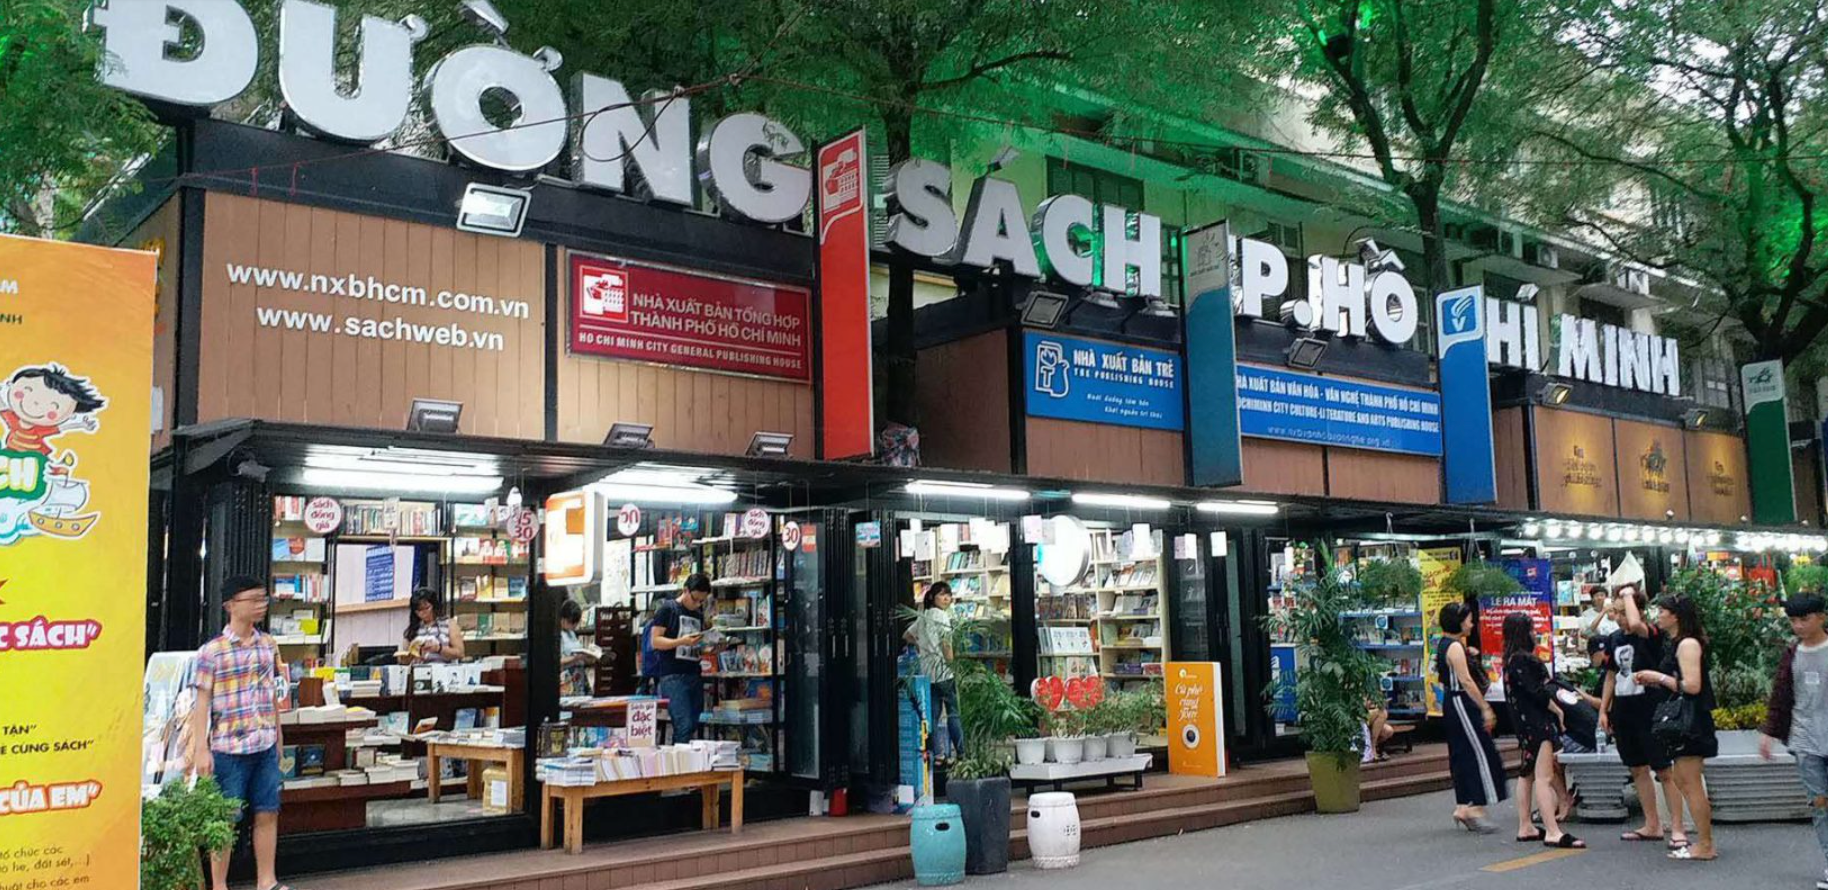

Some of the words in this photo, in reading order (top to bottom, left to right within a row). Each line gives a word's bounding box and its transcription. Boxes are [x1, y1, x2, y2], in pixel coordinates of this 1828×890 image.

[886, 146, 1161, 297] SÁCH
[1558, 313, 1681, 396] MINH
[226, 262, 530, 319] www.nxbhcm.com.vn
[256, 306, 504, 351] www.sachweb.vn
[630, 310, 683, 331] THÀNH
[685, 318, 716, 336] PHỐ
[718, 321, 739, 339] HỒ
[741, 326, 765, 343] CHÍ
[766, 330, 801, 347] MINH
[632, 292, 664, 311] NHÀ
[666, 297, 702, 316] XUẤT
[704, 301, 733, 321] BẢN
[734, 306, 772, 326] TỔNG
[773, 314, 800, 331] HỢP
[578, 332, 594, 343] HO
[596, 333, 615, 347] CHI
[616, 336, 644, 351] MINH
[645, 340, 669, 353] CITY
[670, 344, 715, 359] GENERAL
[716, 349, 772, 366] PUBLISHING
[773, 356, 801, 369] HOUSE
[1073, 348, 1096, 368] NHÀ
[1101, 351, 1128, 372] XUẤT
[1131, 353, 1152, 375] BẢN
[1155, 358, 1174, 378] TRẺ
[1094, 370, 1143, 385] PUBLISHING
[1148, 377, 1174, 389] HOUSE
[1235, 372, 1248, 389] HÀ
[1248, 375, 1269, 393] XUẤT
[1269, 376, 1287, 395] BẢN
[1273, 400, 1289, 415] CITY
[1386, 415, 1421, 431] PUBLISHING
[783, 526, 799, 543] 30
